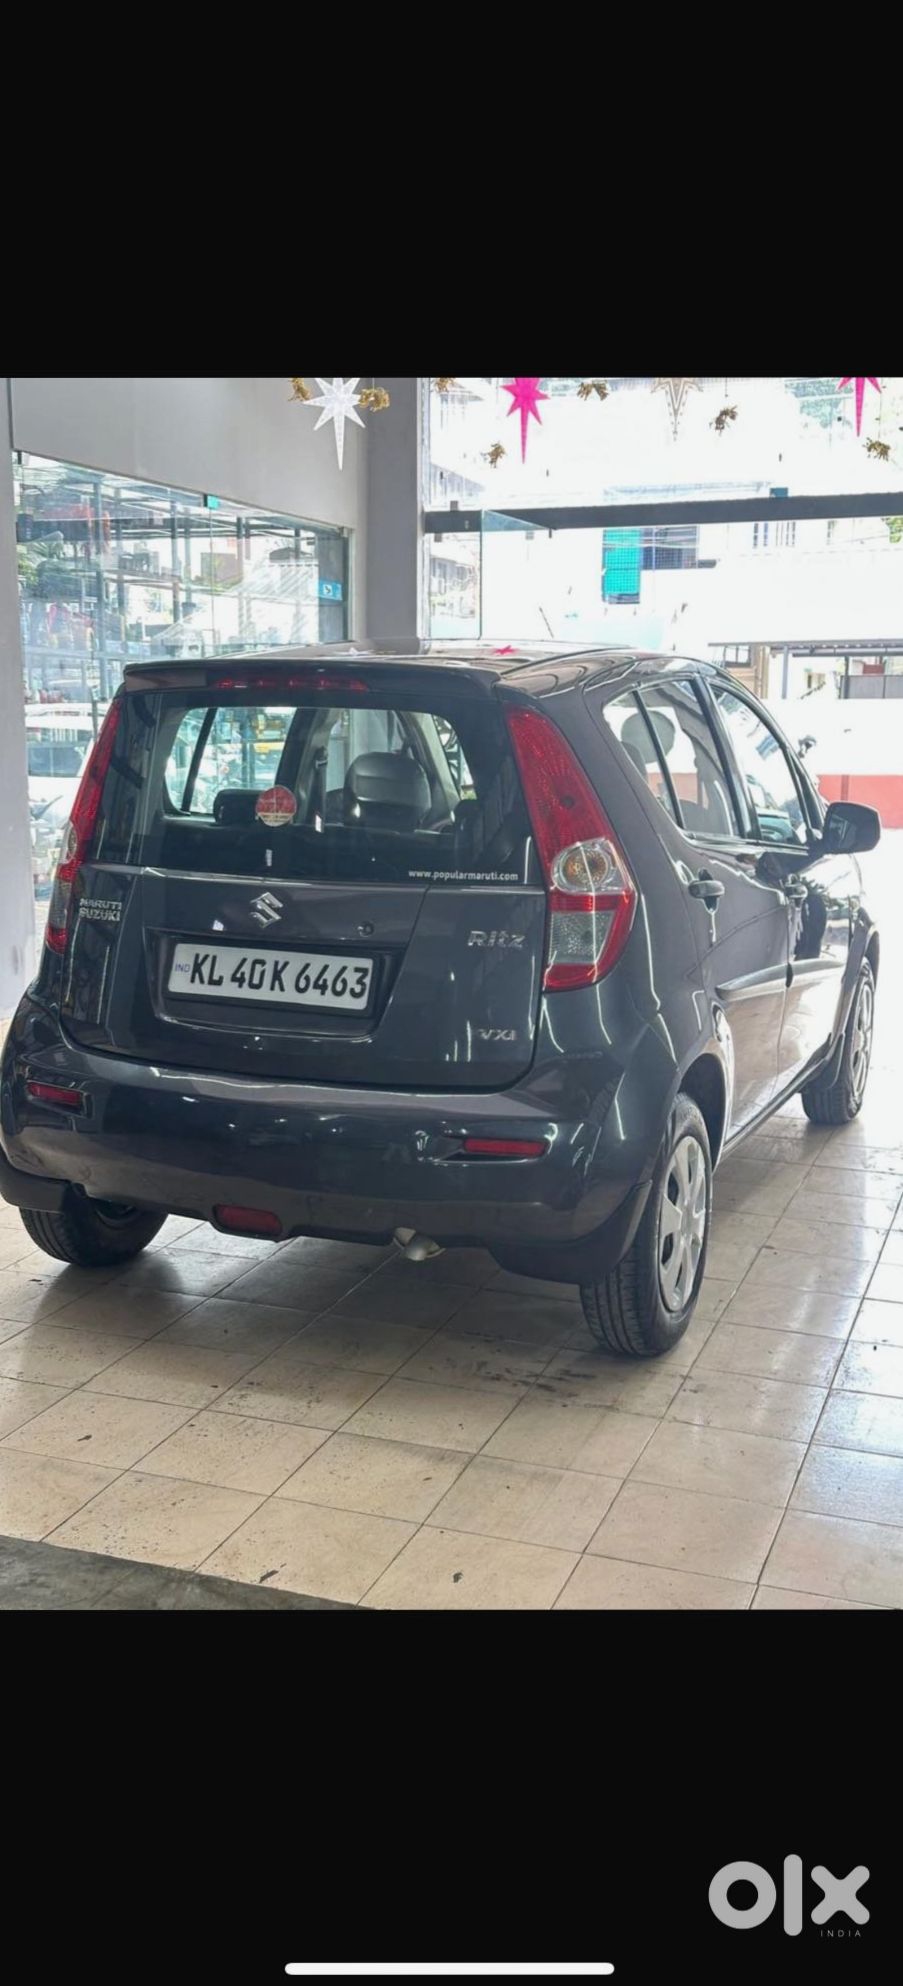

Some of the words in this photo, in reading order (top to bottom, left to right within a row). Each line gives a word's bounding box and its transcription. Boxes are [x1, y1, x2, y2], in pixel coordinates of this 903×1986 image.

[408, 870, 519, 881] www.popularmaruti.com
[80, 898, 122, 910] MARUTI
[80, 907, 121, 921] SUZUKI
[174, 963, 190, 973] IND
[190, 953, 224, 986] KL
[230, 957, 267, 990] 40
[270, 960, 290, 992] K
[294, 963, 370, 999] 6463
